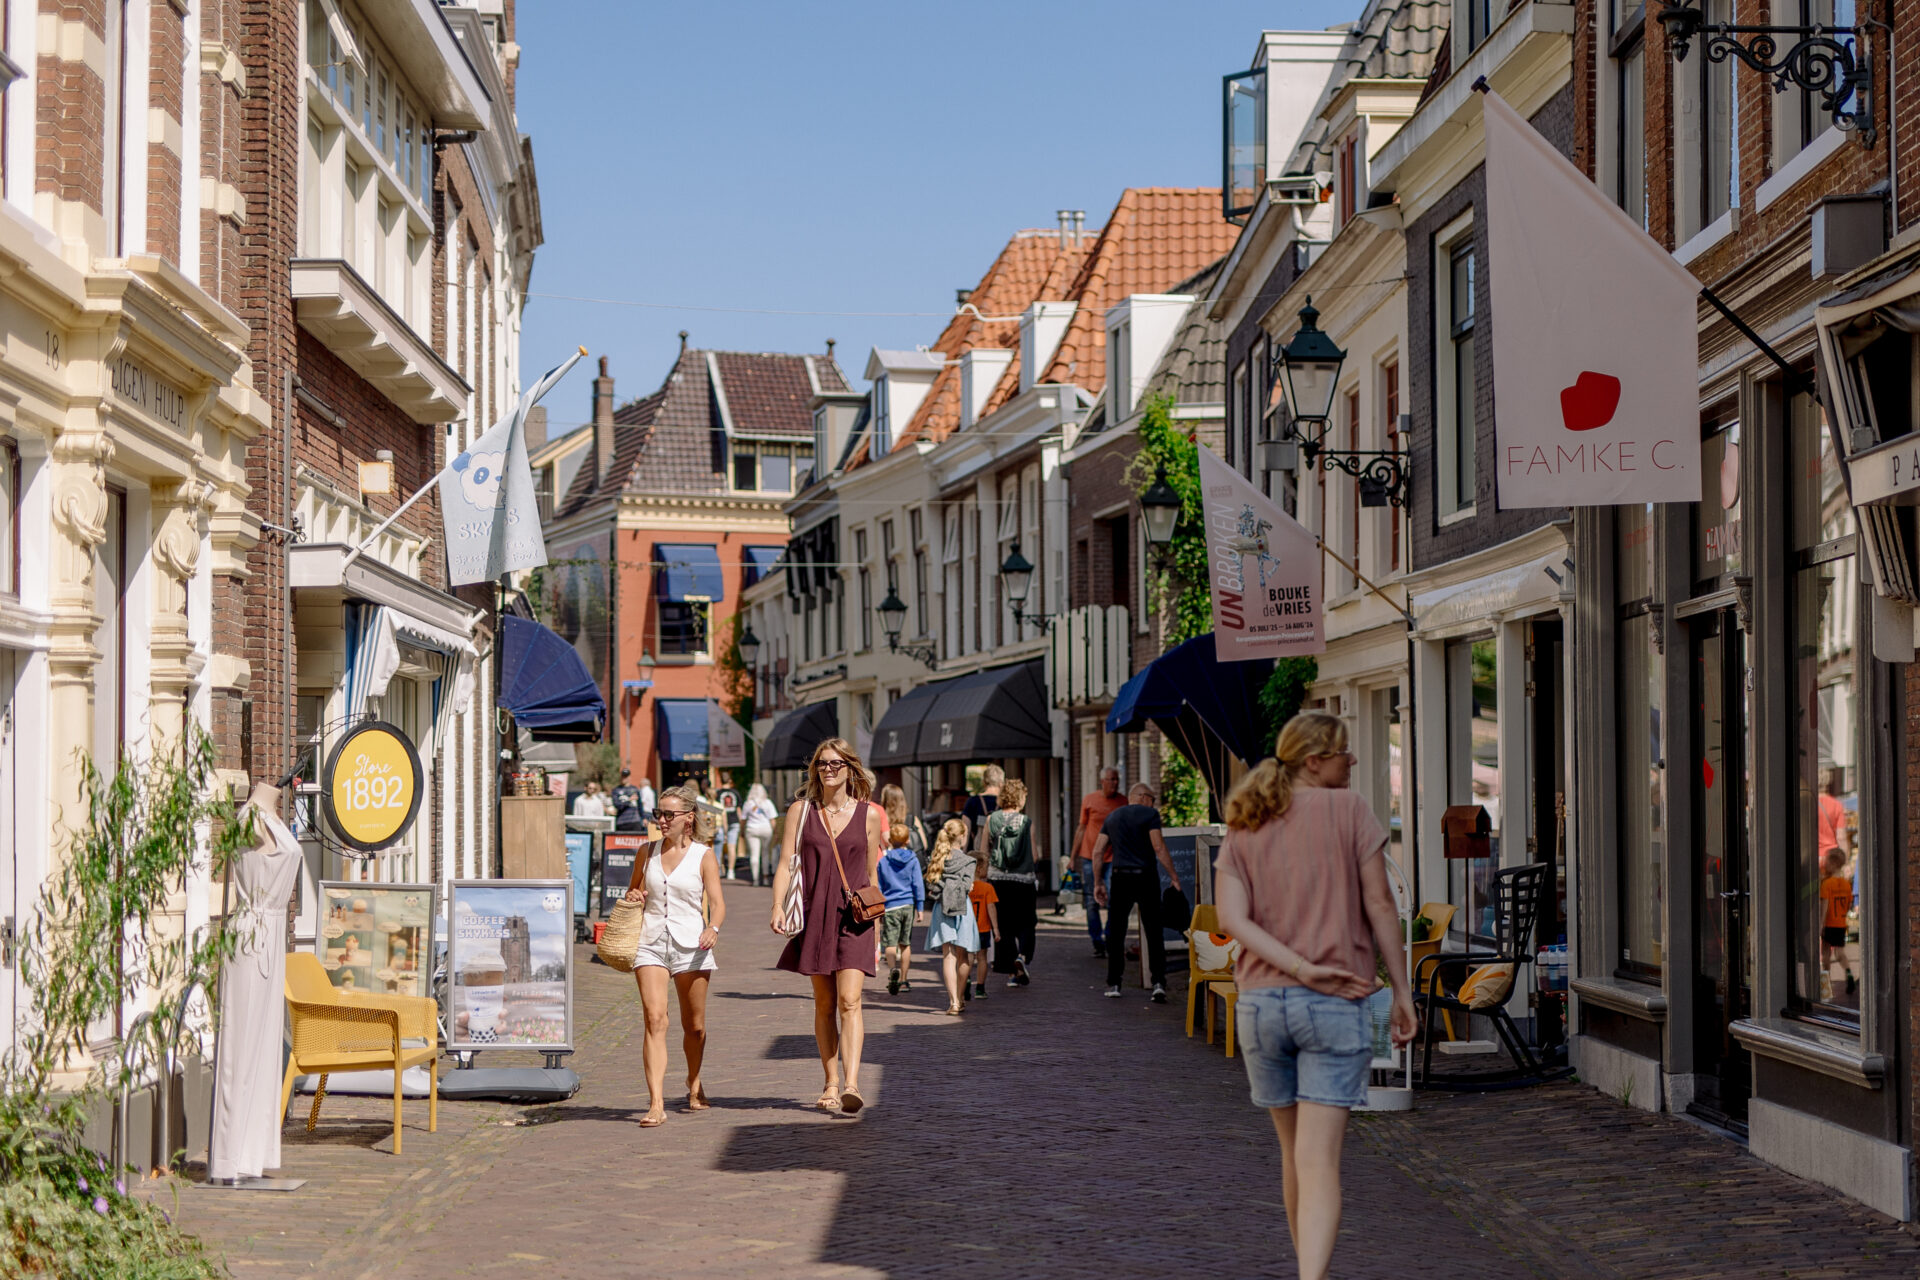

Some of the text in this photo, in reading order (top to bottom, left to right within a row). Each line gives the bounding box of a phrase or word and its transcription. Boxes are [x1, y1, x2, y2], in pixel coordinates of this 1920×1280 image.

[45, 329, 60, 371] 18
[111, 357, 148, 409] EIGEN
[1507, 439, 1685, 476] FAMKE C.
[1210, 501, 1245, 630] UNBROKEN
[1268, 585, 1310, 602] BOUKE
[1258, 624, 1269, 632] JULI
[354, 753, 392, 777] Store
[342, 776, 404, 811] 1892
[457, 928, 511, 939] SKYKISS
[463, 915, 506, 926] COFFEE
